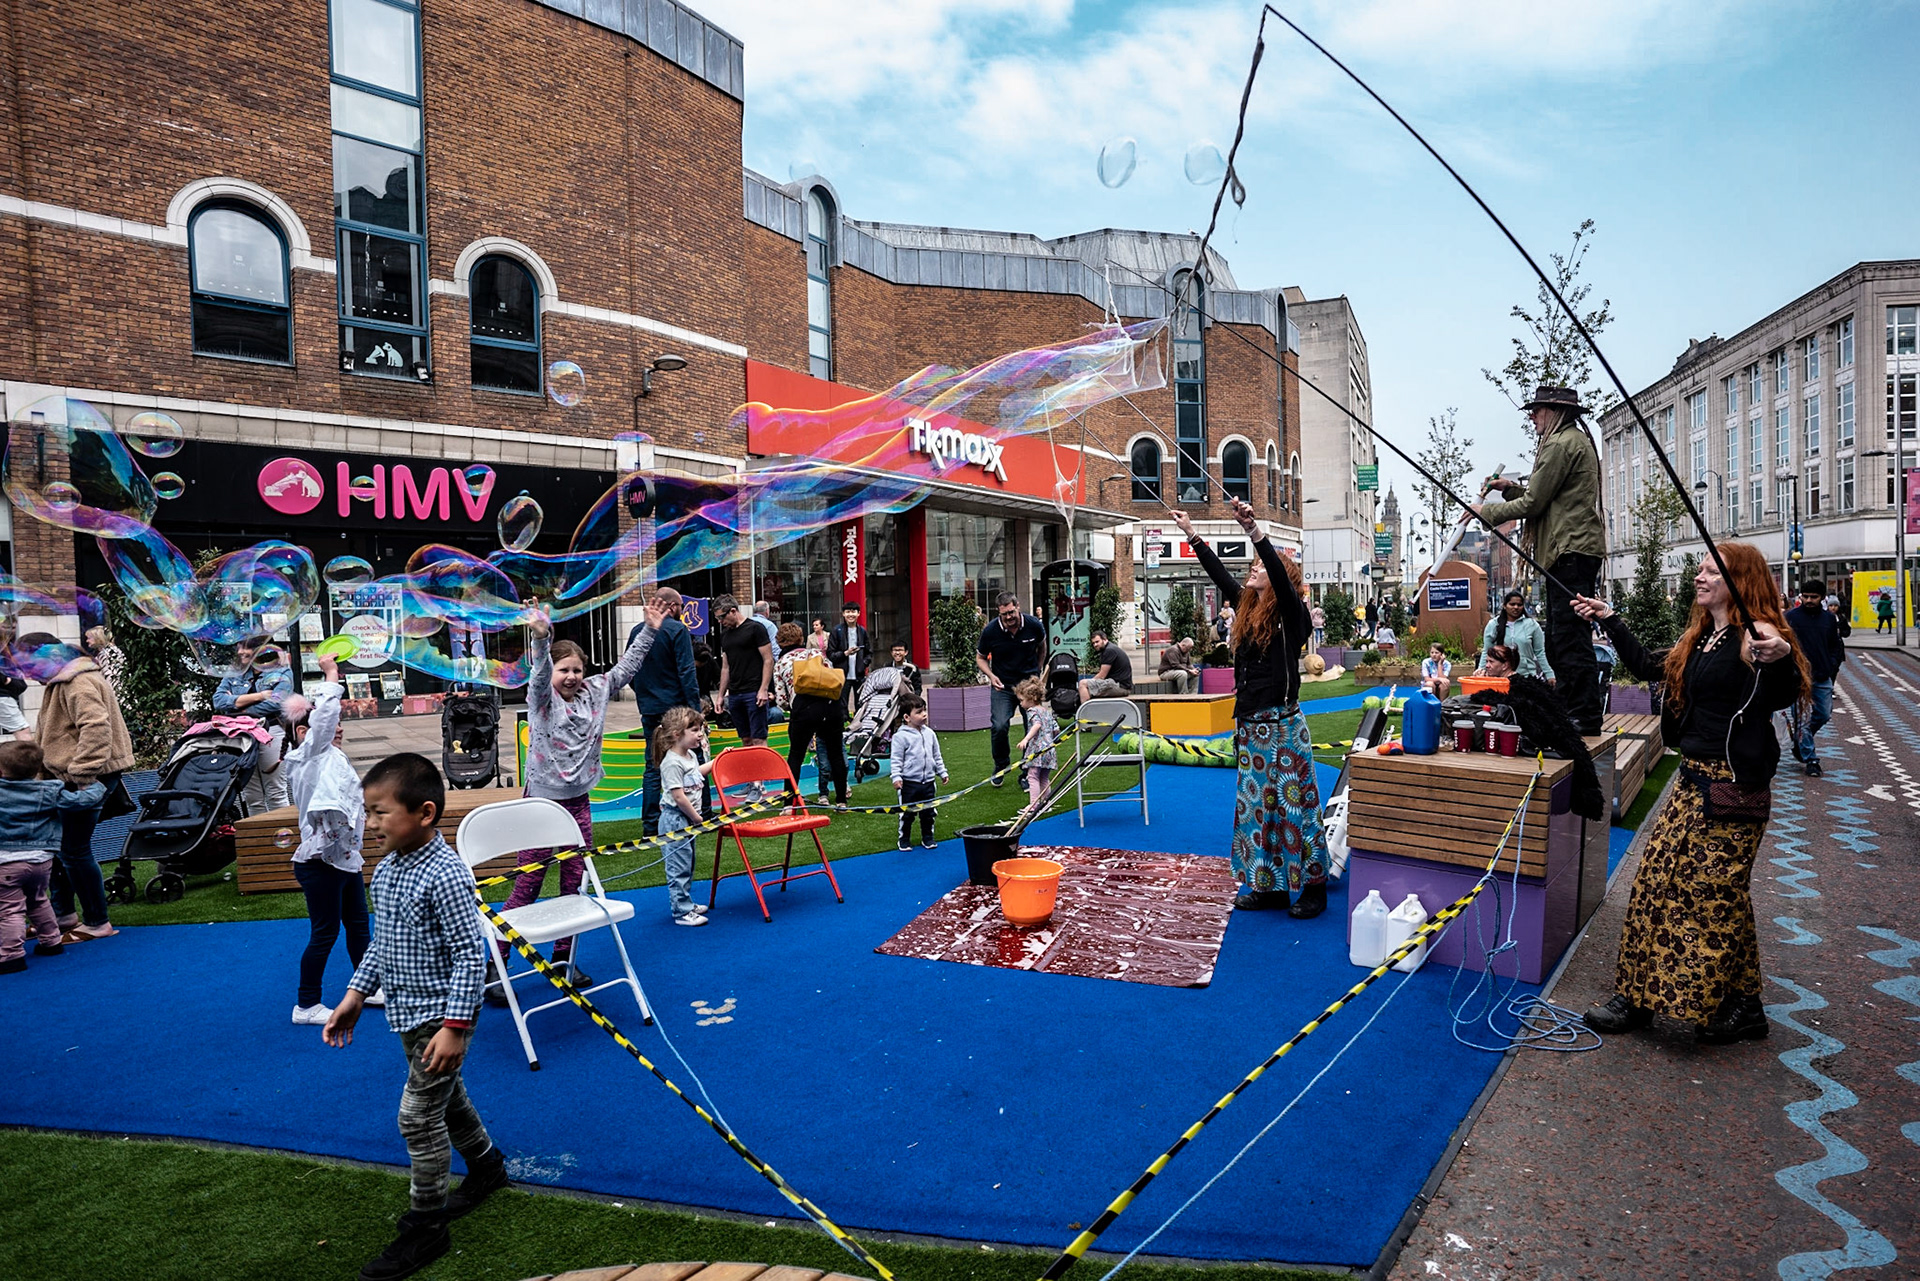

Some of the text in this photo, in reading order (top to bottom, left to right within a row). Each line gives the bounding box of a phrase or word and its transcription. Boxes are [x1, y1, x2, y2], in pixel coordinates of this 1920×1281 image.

[336, 461, 497, 522] HMV
[629, 490, 647, 505] HMV
[1304, 571, 1346, 580] OFFICE
